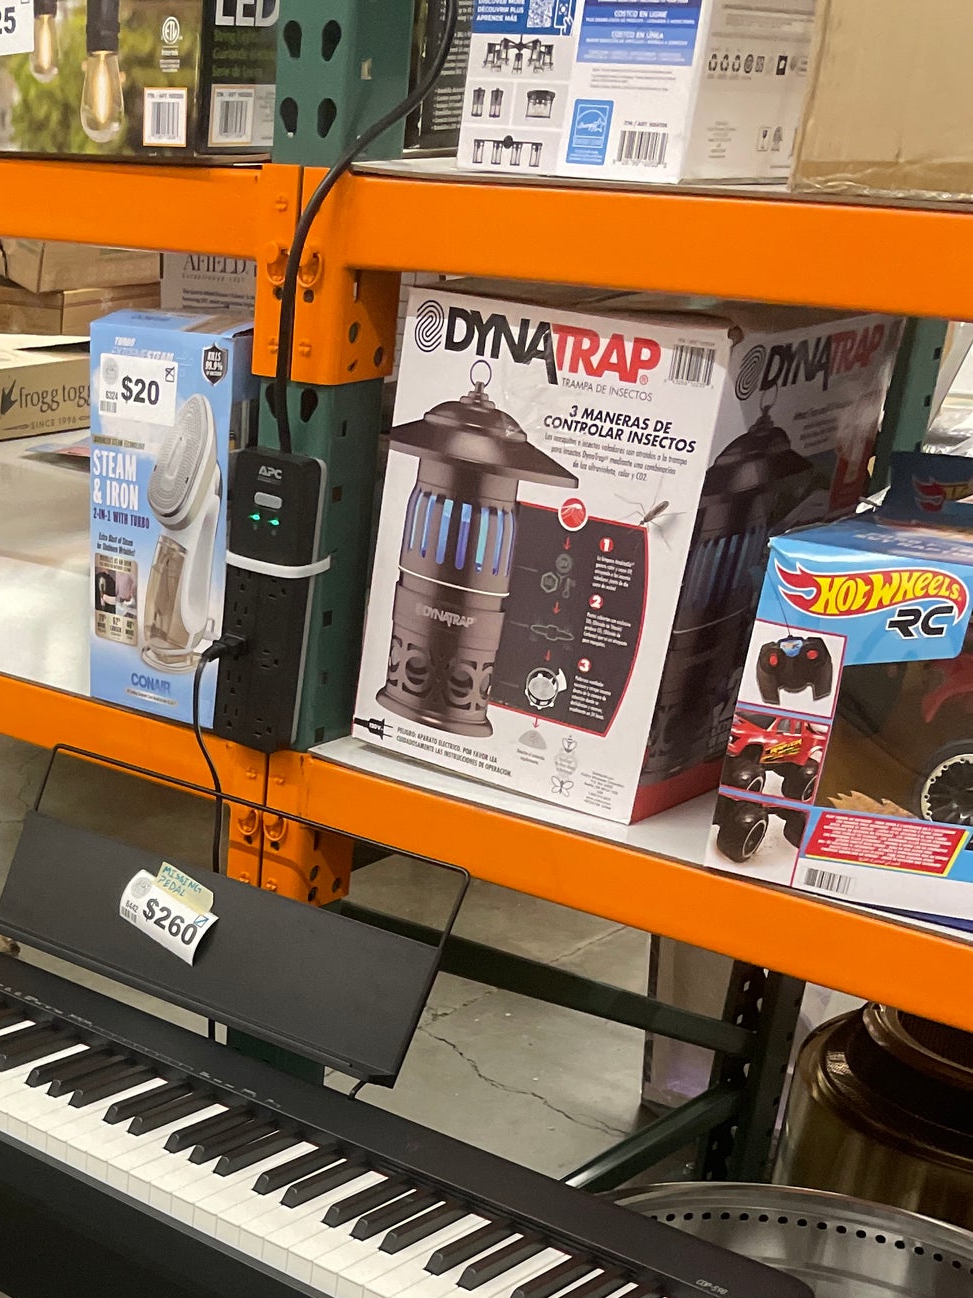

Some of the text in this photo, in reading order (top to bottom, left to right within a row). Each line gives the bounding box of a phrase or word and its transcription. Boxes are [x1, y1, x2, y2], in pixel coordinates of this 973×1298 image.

[445, 306, 662, 385] DYNATRAP
[759, 324, 885, 392] DYNATRAP
[18, 384, 91, 413] frogg togg
[121, 376, 160, 405] $20
[562, 377, 653, 402] TRAMPA DE INSECTOS
[30, 419, 56, 430] SINCE
[543, 415, 697, 454] CONTROLAR INSECTOS
[569, 405, 674, 435] 3 MANERAS DE
[93, 449, 137, 482] STEAM
[258, 465, 283, 480] APC
[93, 479, 139, 511] & IRON
[93, 507, 150, 530] 2-IN-1 WITH TURBO
[423, 605, 474, 628] DYNATRAP
[886, 605, 954, 639] RC
[130, 672, 171, 694] CONAIR
[396, 735, 435, 753] CUIDADOSAMENTE
[435, 747, 444, 756] LAS
[444, 750, 478, 767] INSTRUCCIONES
[478, 760, 485, 769] DE
[417, 732, 438, 745] APARATO
[462, 747, 473, 756] POR
[473, 750, 489, 761] FAVOR
[489, 755, 498, 764] LEA
[158, 875, 185, 897] PEDAL
[162, 866, 202, 894] MISSING
[142, 897, 198, 946] $260
